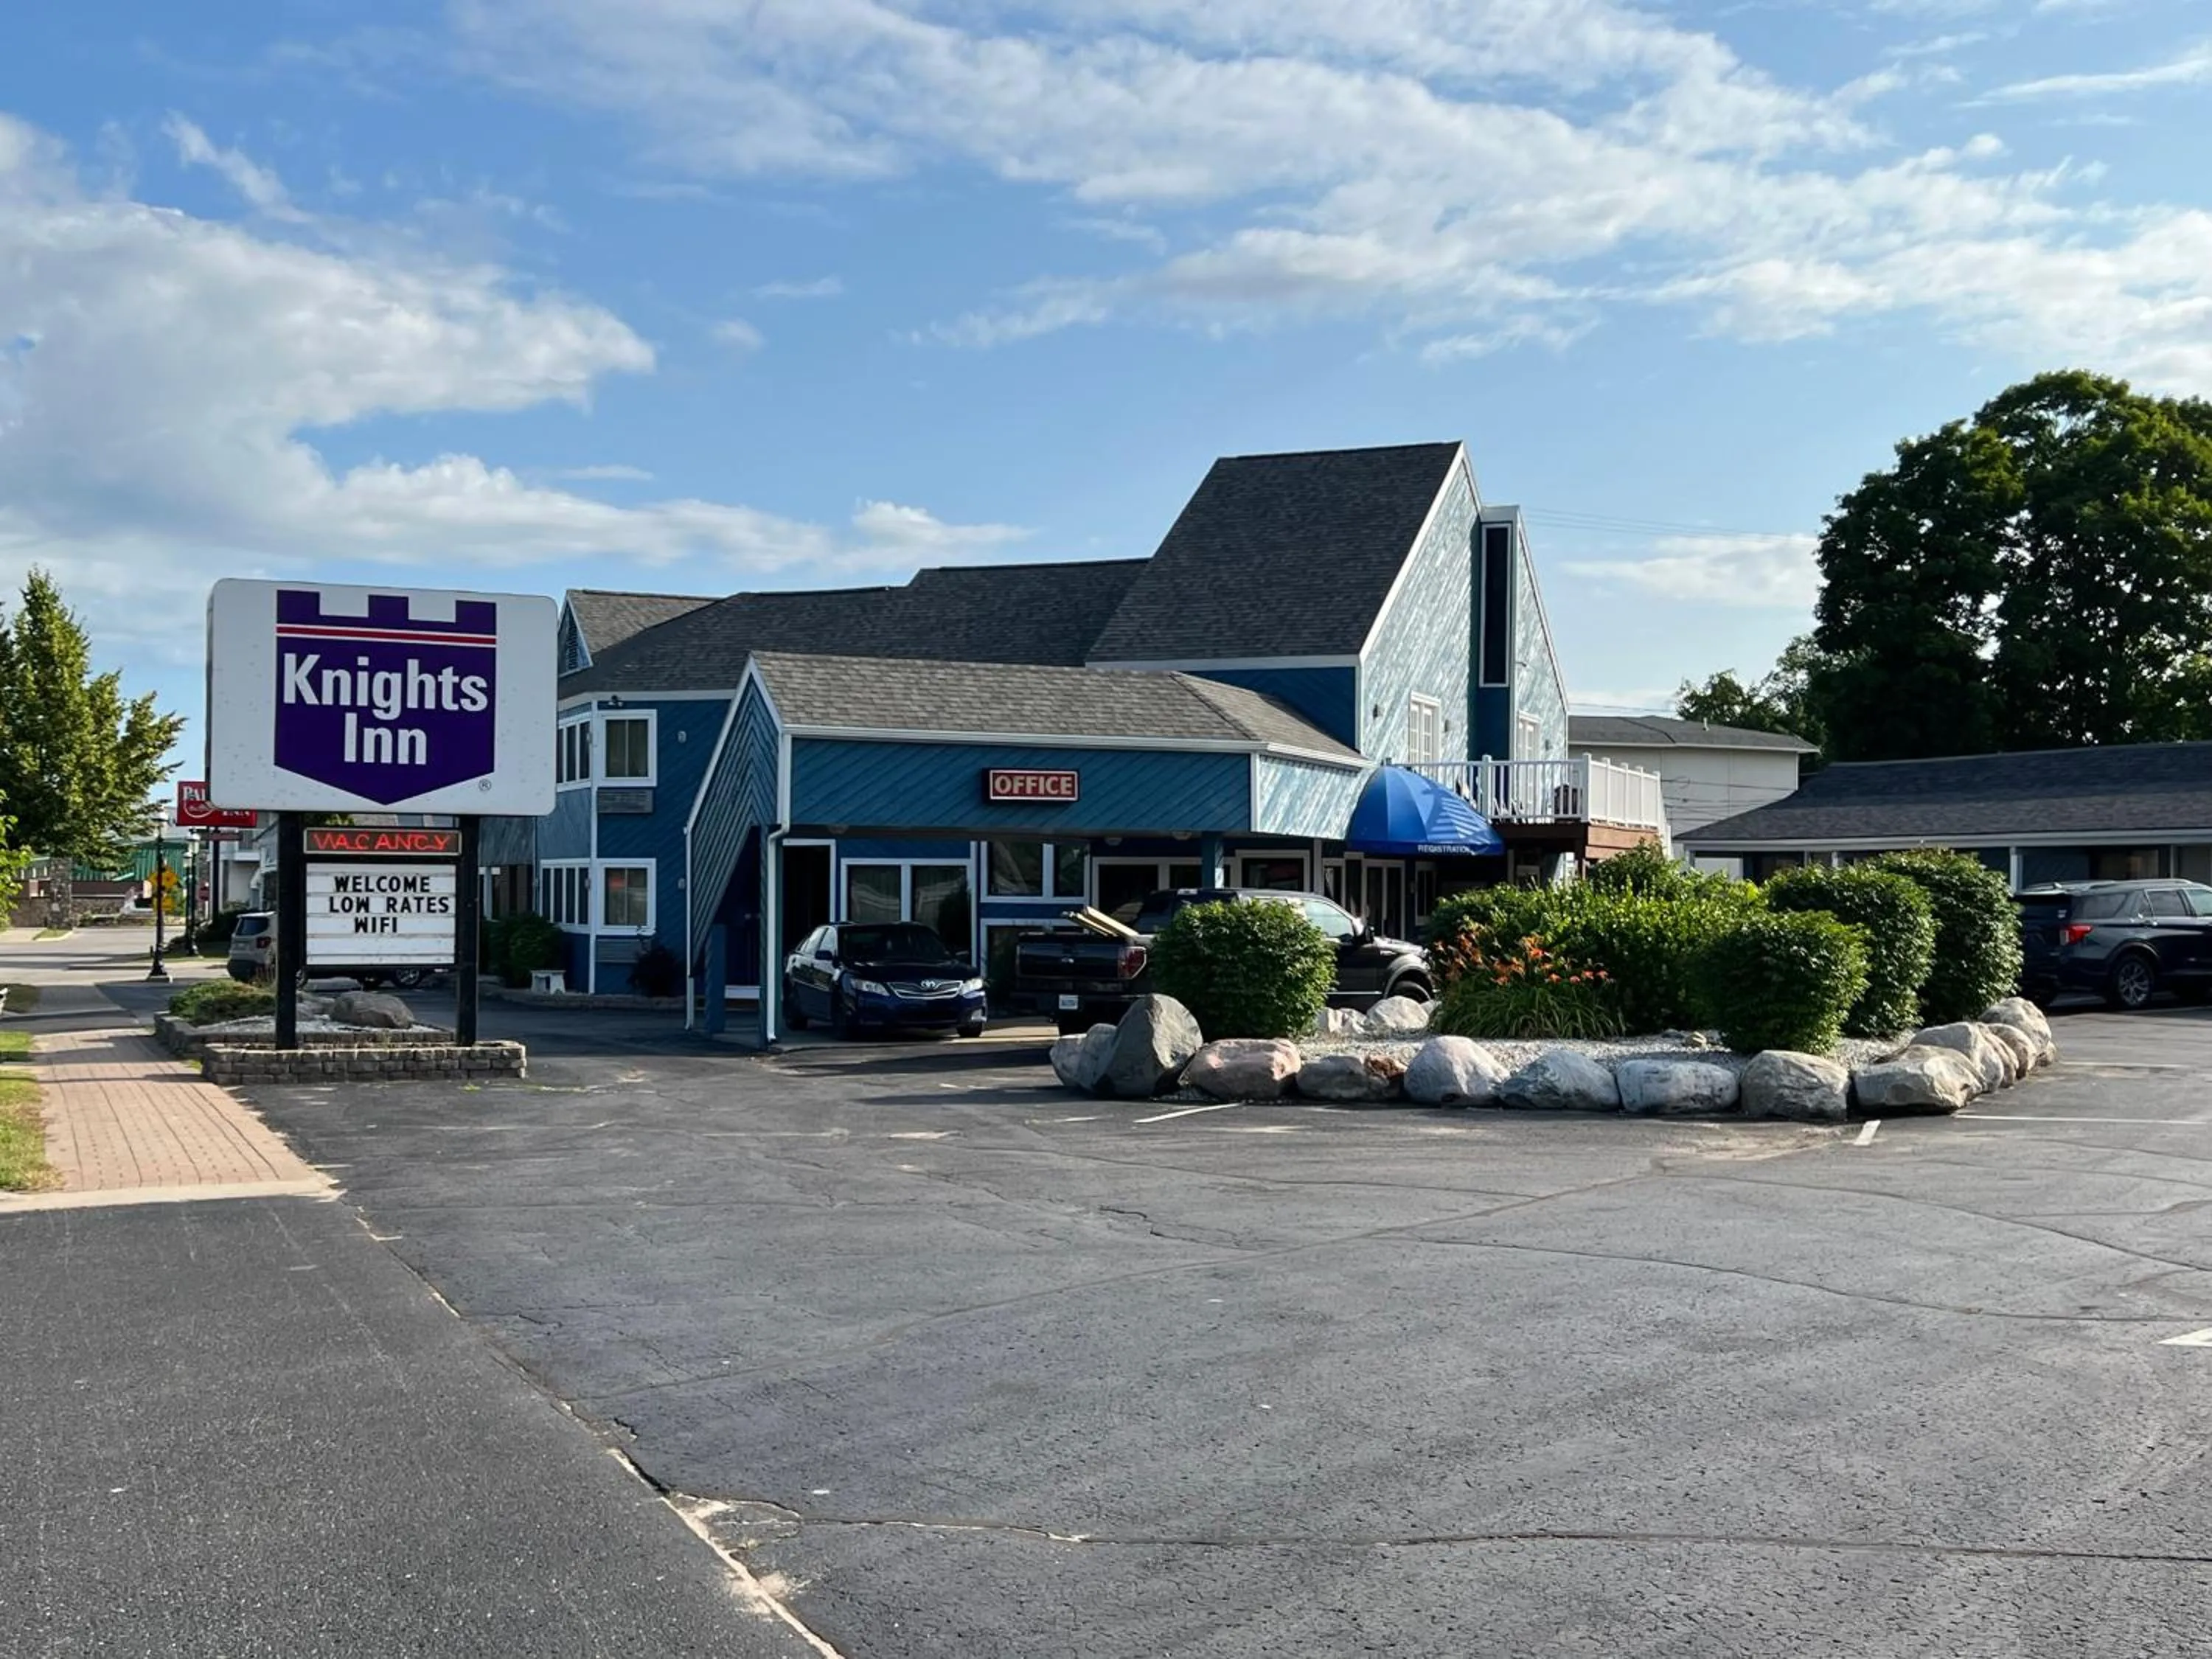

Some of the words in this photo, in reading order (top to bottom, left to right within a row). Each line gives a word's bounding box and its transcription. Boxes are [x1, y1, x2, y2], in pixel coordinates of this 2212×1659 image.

[283, 653, 489, 720] Knights
[344, 712, 428, 765] Inn
[995, 775, 1073, 796] OFFICE
[313, 832, 451, 851] VACANCY
[334, 875, 431, 893] WELCOME
[329, 897, 369, 914] LOW
[386, 897, 450, 914] RATES
[354, 917, 398, 933] WIFI
